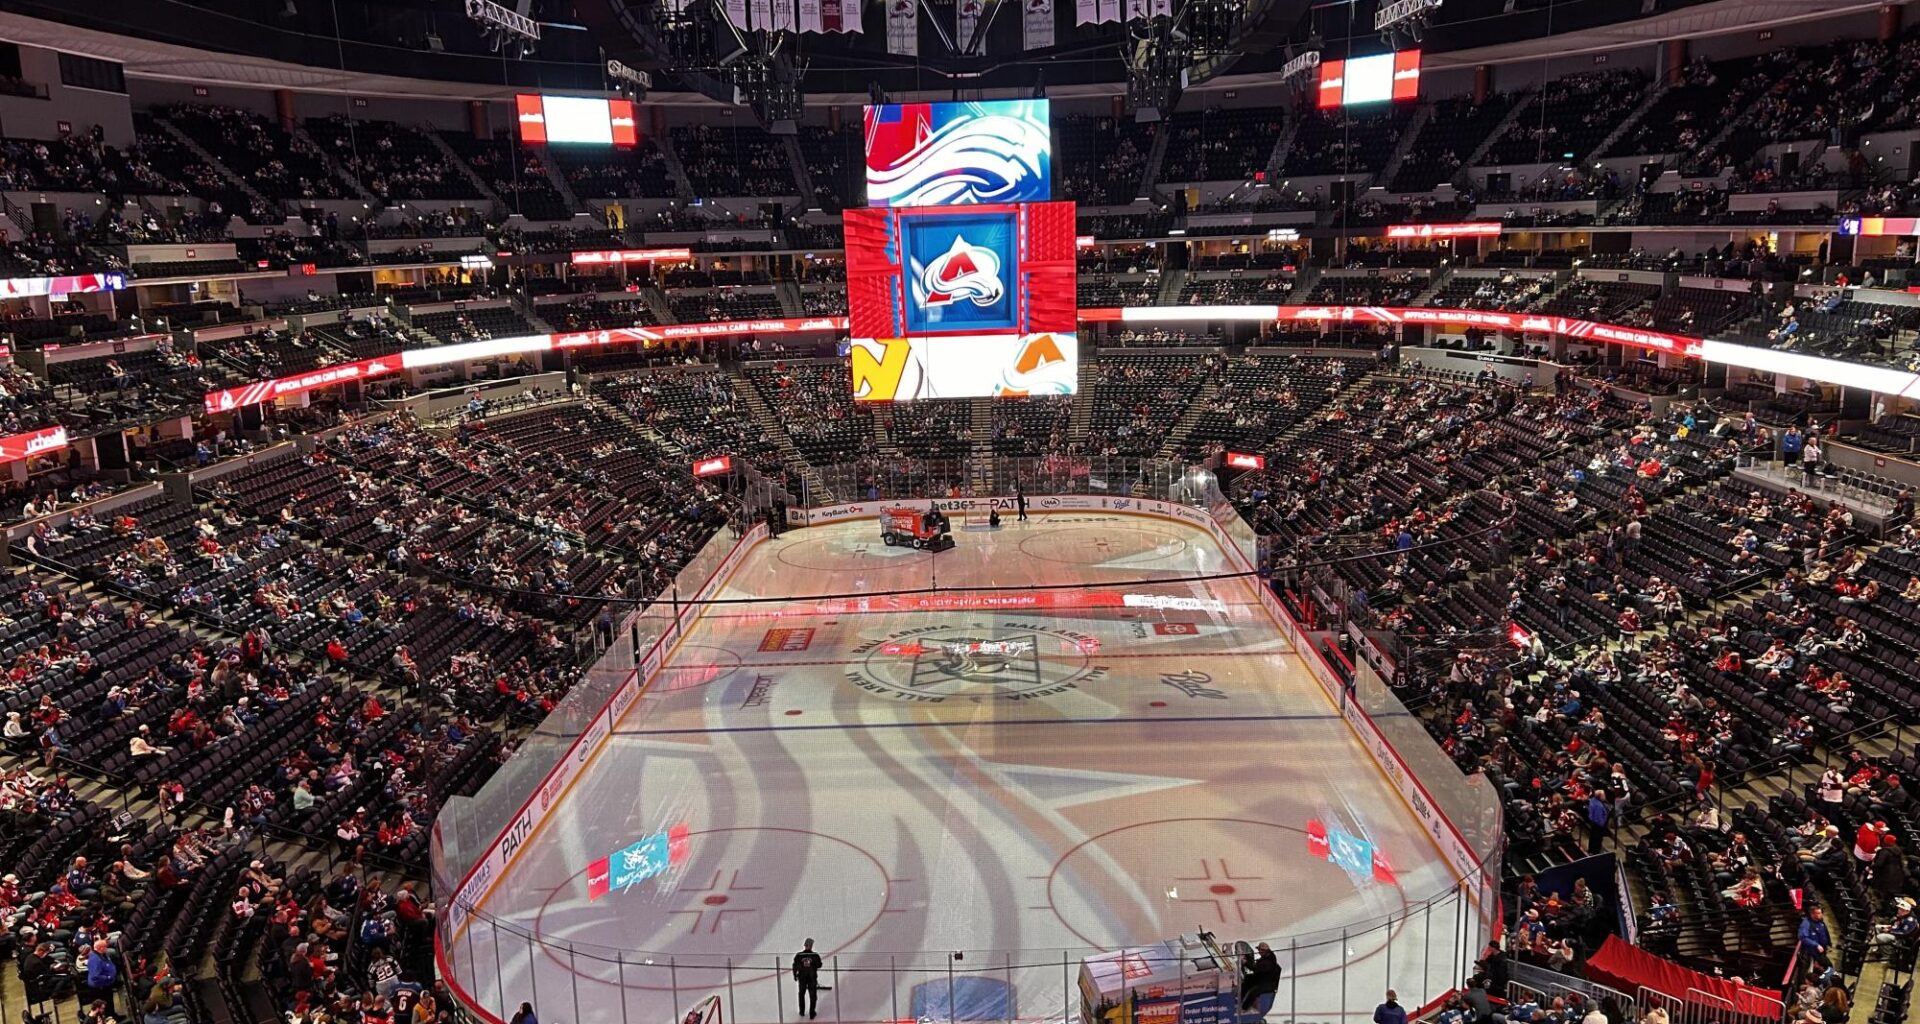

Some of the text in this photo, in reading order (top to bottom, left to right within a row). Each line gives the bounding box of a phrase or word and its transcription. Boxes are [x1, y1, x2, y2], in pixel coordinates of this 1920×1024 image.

[664, 322, 784, 336] OFFICIAL HEALTH CARE PARTNER
[24, 426, 67, 455] uchealth
[932, 500, 976, 511] bet365
[989, 498, 1030, 510] PATH
[821, 507, 850, 518] KeyBank
[1003, 622, 1049, 633] BALL
[851, 624, 952, 655] BALL ARENA
[844, 670, 945, 704] BALL ARENA
[1005, 683, 1079, 702] ARENA
[501, 808, 532, 865] PATH
[398, 996, 408, 1011] 6
[1185, 1007, 1201, 1015] Order
